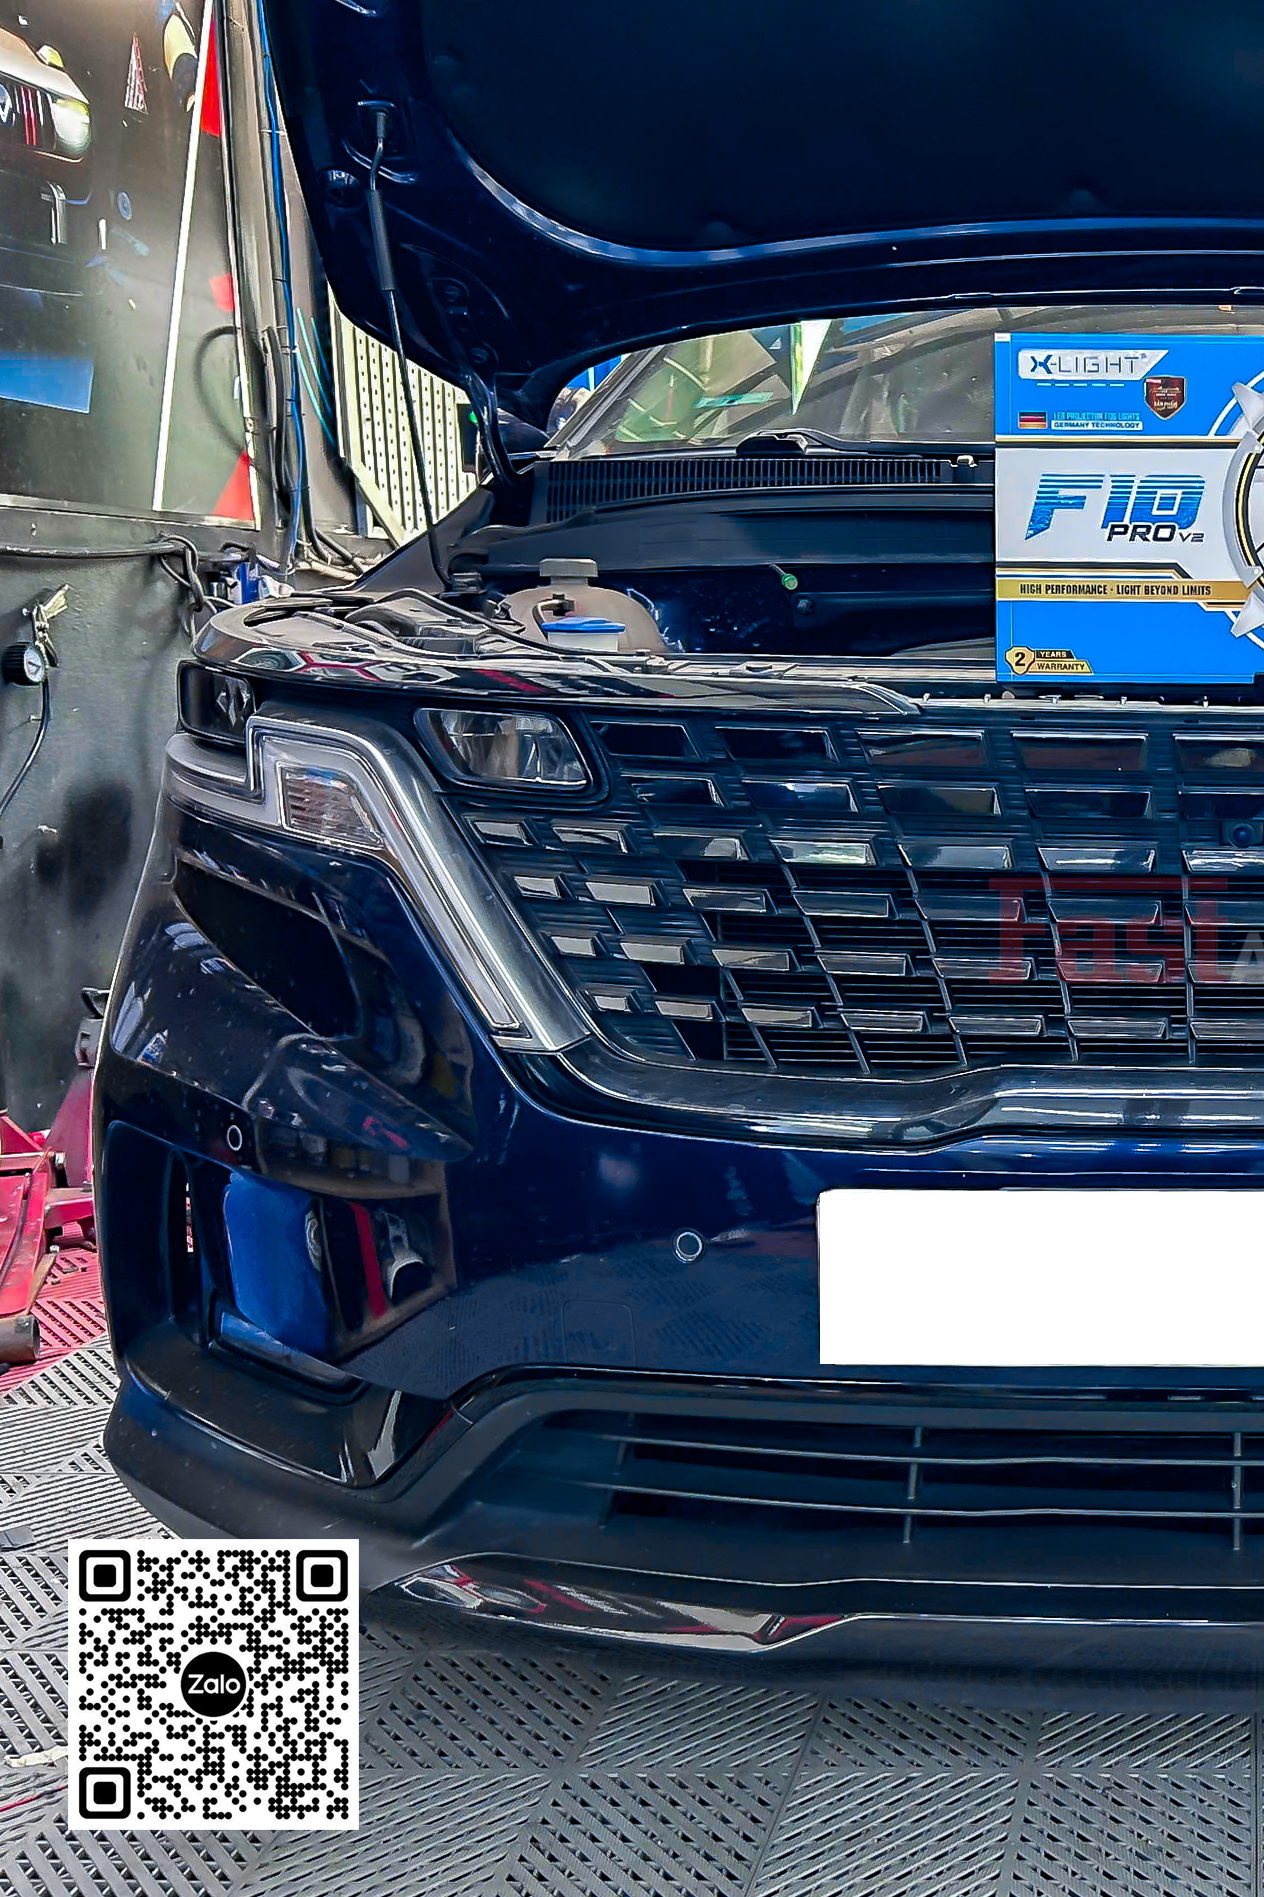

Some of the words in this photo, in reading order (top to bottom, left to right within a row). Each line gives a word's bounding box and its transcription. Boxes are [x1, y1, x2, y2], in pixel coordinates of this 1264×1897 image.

[1030, 355, 1139, 374] X-LIGHT
[1025, 474, 1206, 540] F10
[1106, 523, 1177, 542] PRO
[1020, 583, 1042, 595] HIGH
[1045, 583, 1108, 595] PERFORMANCE
[1116, 584, 1141, 596] LIGHT
[1144, 584, 1179, 596] BEYOND
[1181, 585, 1212, 596] LIMITS
[1014, 651, 1026, 667] 2
[1036, 662, 1085, 671] WARRANTY
